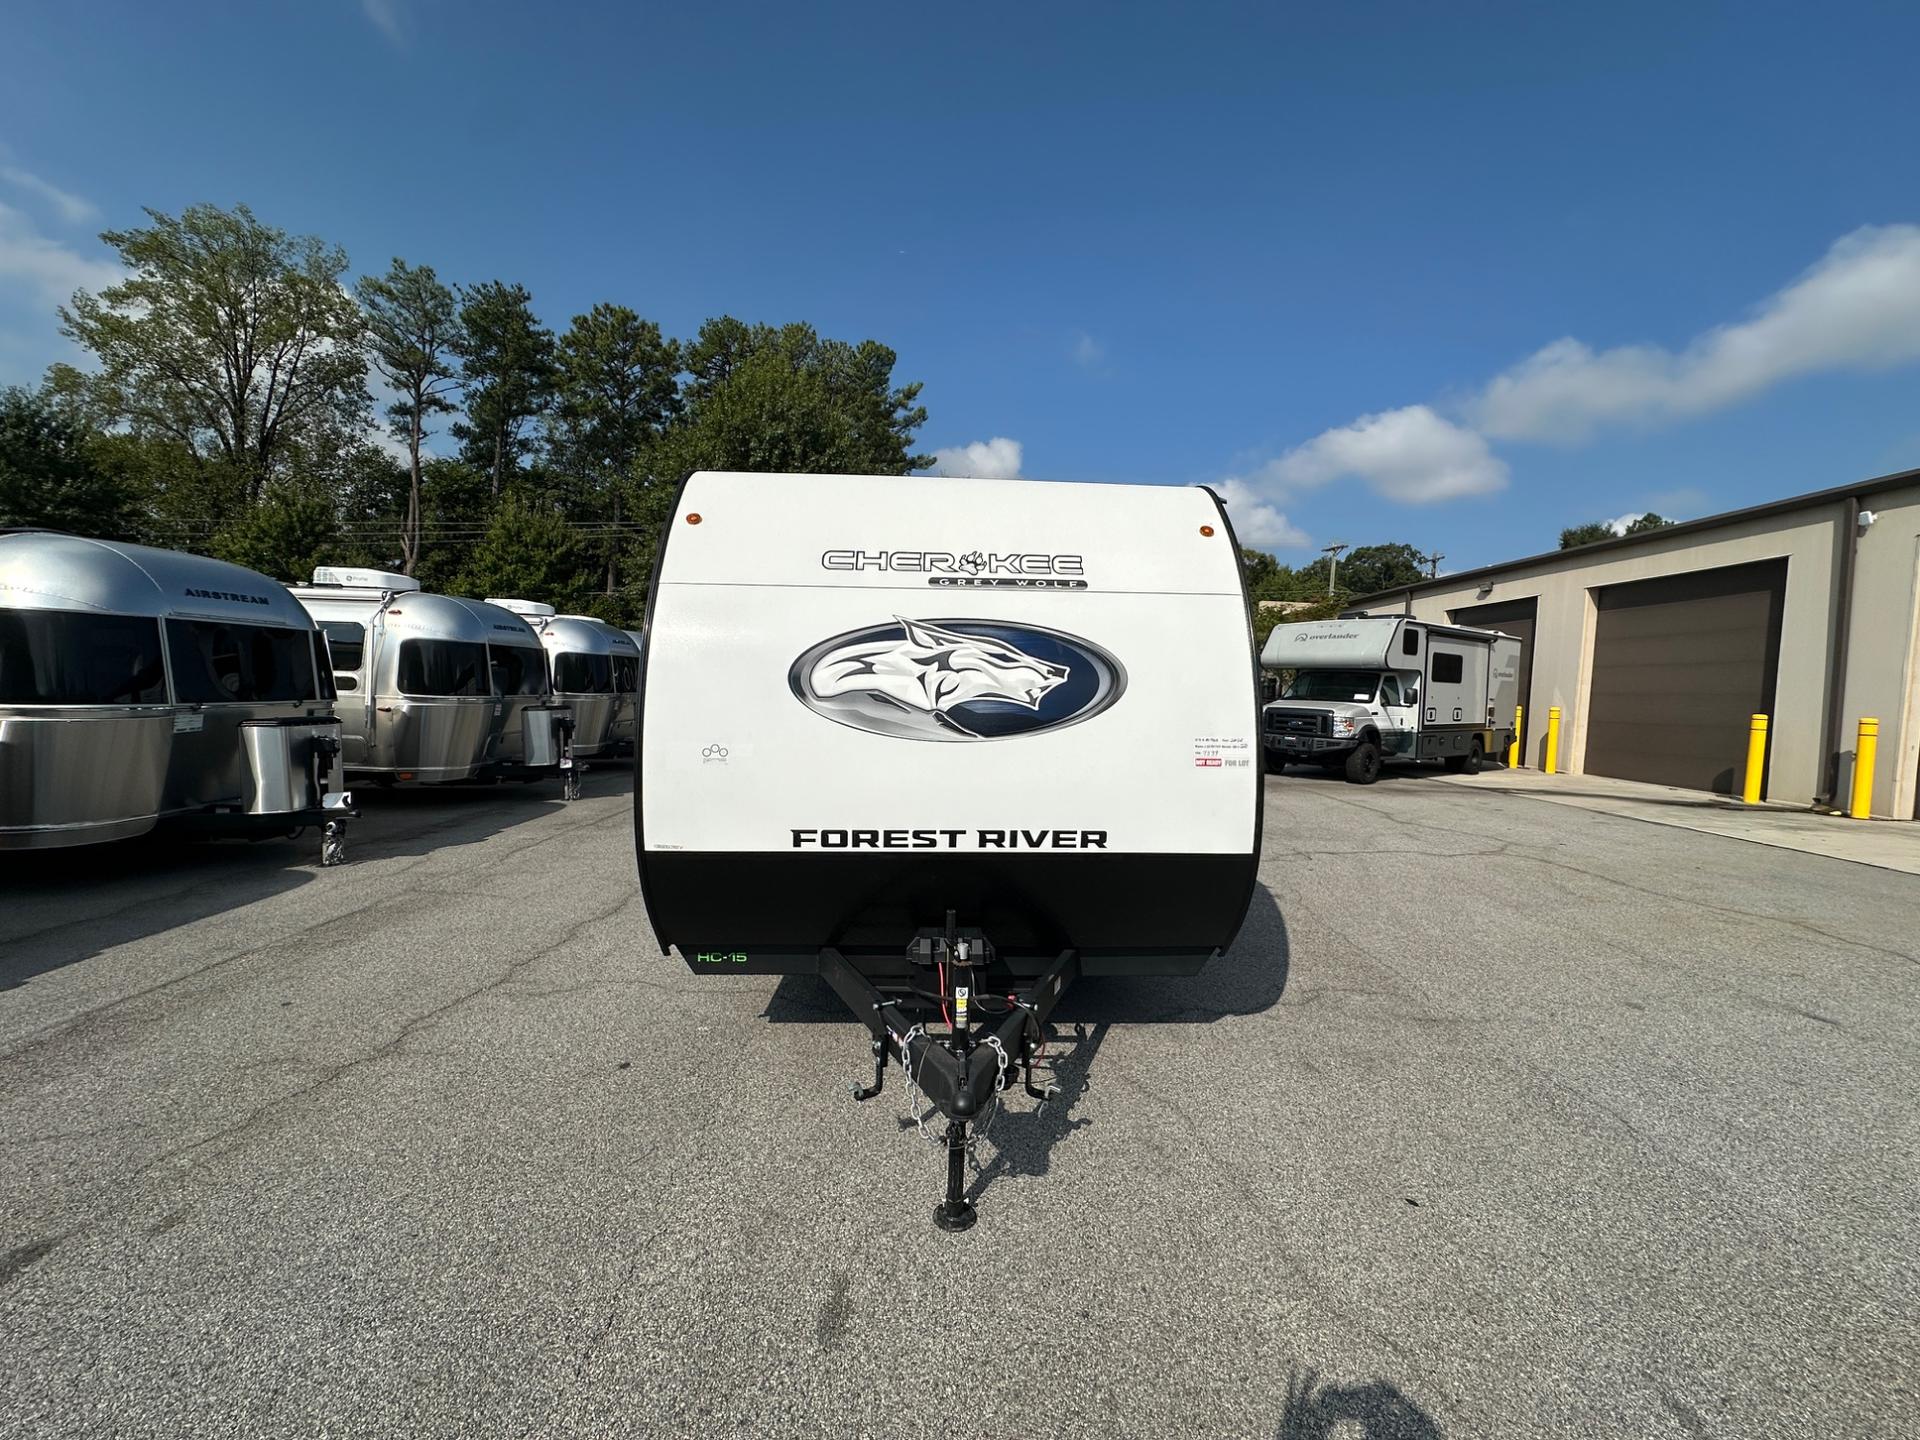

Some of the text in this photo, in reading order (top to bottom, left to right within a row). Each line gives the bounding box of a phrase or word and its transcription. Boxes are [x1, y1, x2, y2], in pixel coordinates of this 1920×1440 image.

[939, 578, 1079, 588] GREY WOLF
[185, 588, 270, 606] AIRSTREAM
[1309, 632, 1360, 641] overlander
[1225, 759, 1237, 767] FOR
[1238, 759, 1249, 767] LOT
[790, 829, 1108, 849] FOREST RIVER
[697, 952, 747, 962] HC-15
